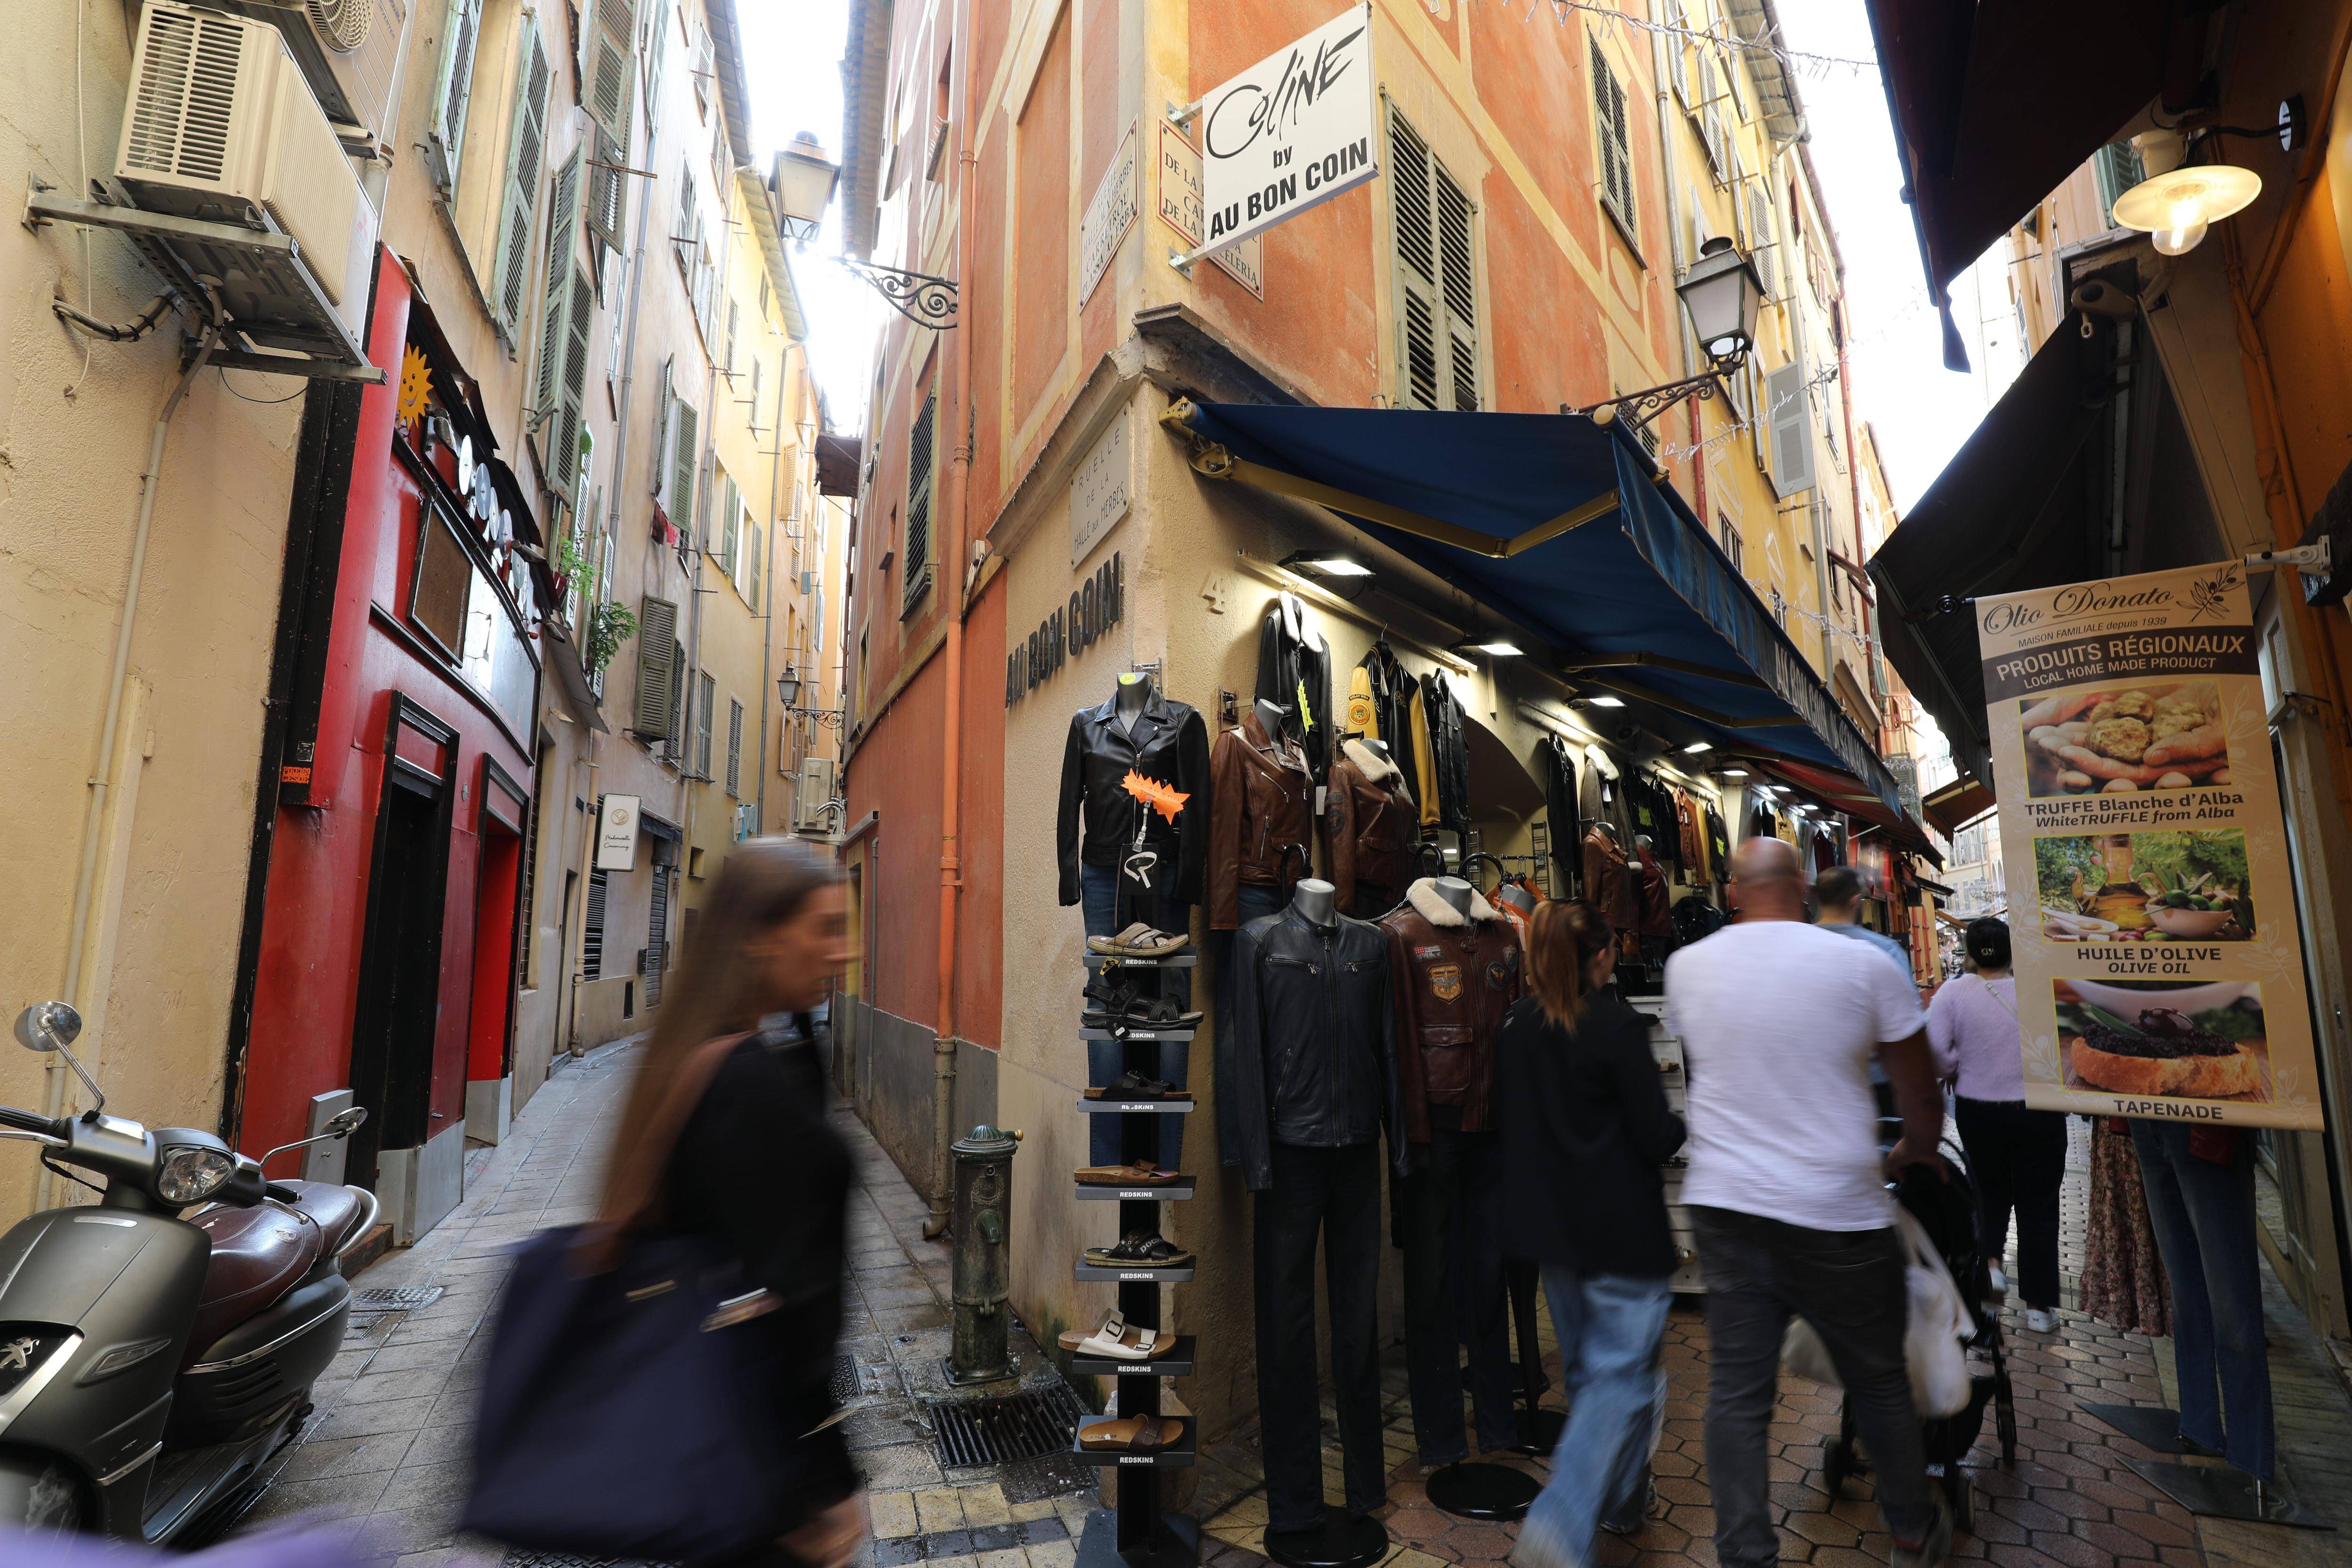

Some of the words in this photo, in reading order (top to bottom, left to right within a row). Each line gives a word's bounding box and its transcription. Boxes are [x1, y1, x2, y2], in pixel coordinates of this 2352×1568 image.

[1165, 151, 1179, 175] DE
[1184, 168, 1197, 191] LA
[1273, 145, 1292, 168] by
[1084, 218, 1098, 257] HALLE
[1100, 196, 1109, 225] AUX
[1112, 151, 1132, 204] HERBES
[1097, 164, 1116, 215] RUELLE
[1210, 206, 1239, 241] AU
[1248, 173, 1296, 221] BON
[1305, 137, 1367, 191] COIN
[1165, 197, 1179, 222] DE
[1184, 213, 1197, 236] LA
[1082, 251, 1103, 299] PLASSA
[1105, 233, 1112, 257] AI
[1116, 195, 1134, 241] ERBA
[1079, 430, 1120, 492] RUELLE
[1086, 492, 1095, 507] DE
[1101, 475, 1109, 490] LA
[1074, 524, 1090, 553] HALLE
[1101, 480, 1124, 524] HERBES
[1983, 603, 2044, 635] Olio
[2052, 581, 2174, 619] Donato
[1005, 642, 1025, 708] AU
[1028, 605, 1063, 691] BON
[1068, 550, 1121, 656] COIN
[2018, 632, 2054, 647] MAISON
[2056, 622, 2104, 639] FAMILIALE
[2106, 619, 2138, 632] depuis
[2142, 616, 2167, 627] 1939
[1996, 643, 2102, 681] PRODUITS
[2109, 635, 2245, 659] RÉGIONAUX
[2024, 674, 2064, 689] LOCAL
[2066, 663, 2105, 679] HOME
[2107, 658, 2147, 671] MADE
[2151, 657, 2217, 669] PRODUCT
[2025, 800, 2094, 816] TRUFFE
[2098, 796, 2174, 812] Blanche
[2151, 810, 2191, 825] from
[2195, 806, 2235, 819] Alba
[2077, 947, 2134, 961] HUILE
[2140, 947, 2221, 961] D’OLIVE
[2108, 962, 2157, 974] OLIVE
[2162, 963, 2191, 974] OIL
[2113, 1099, 2224, 1120] TAPENADE
